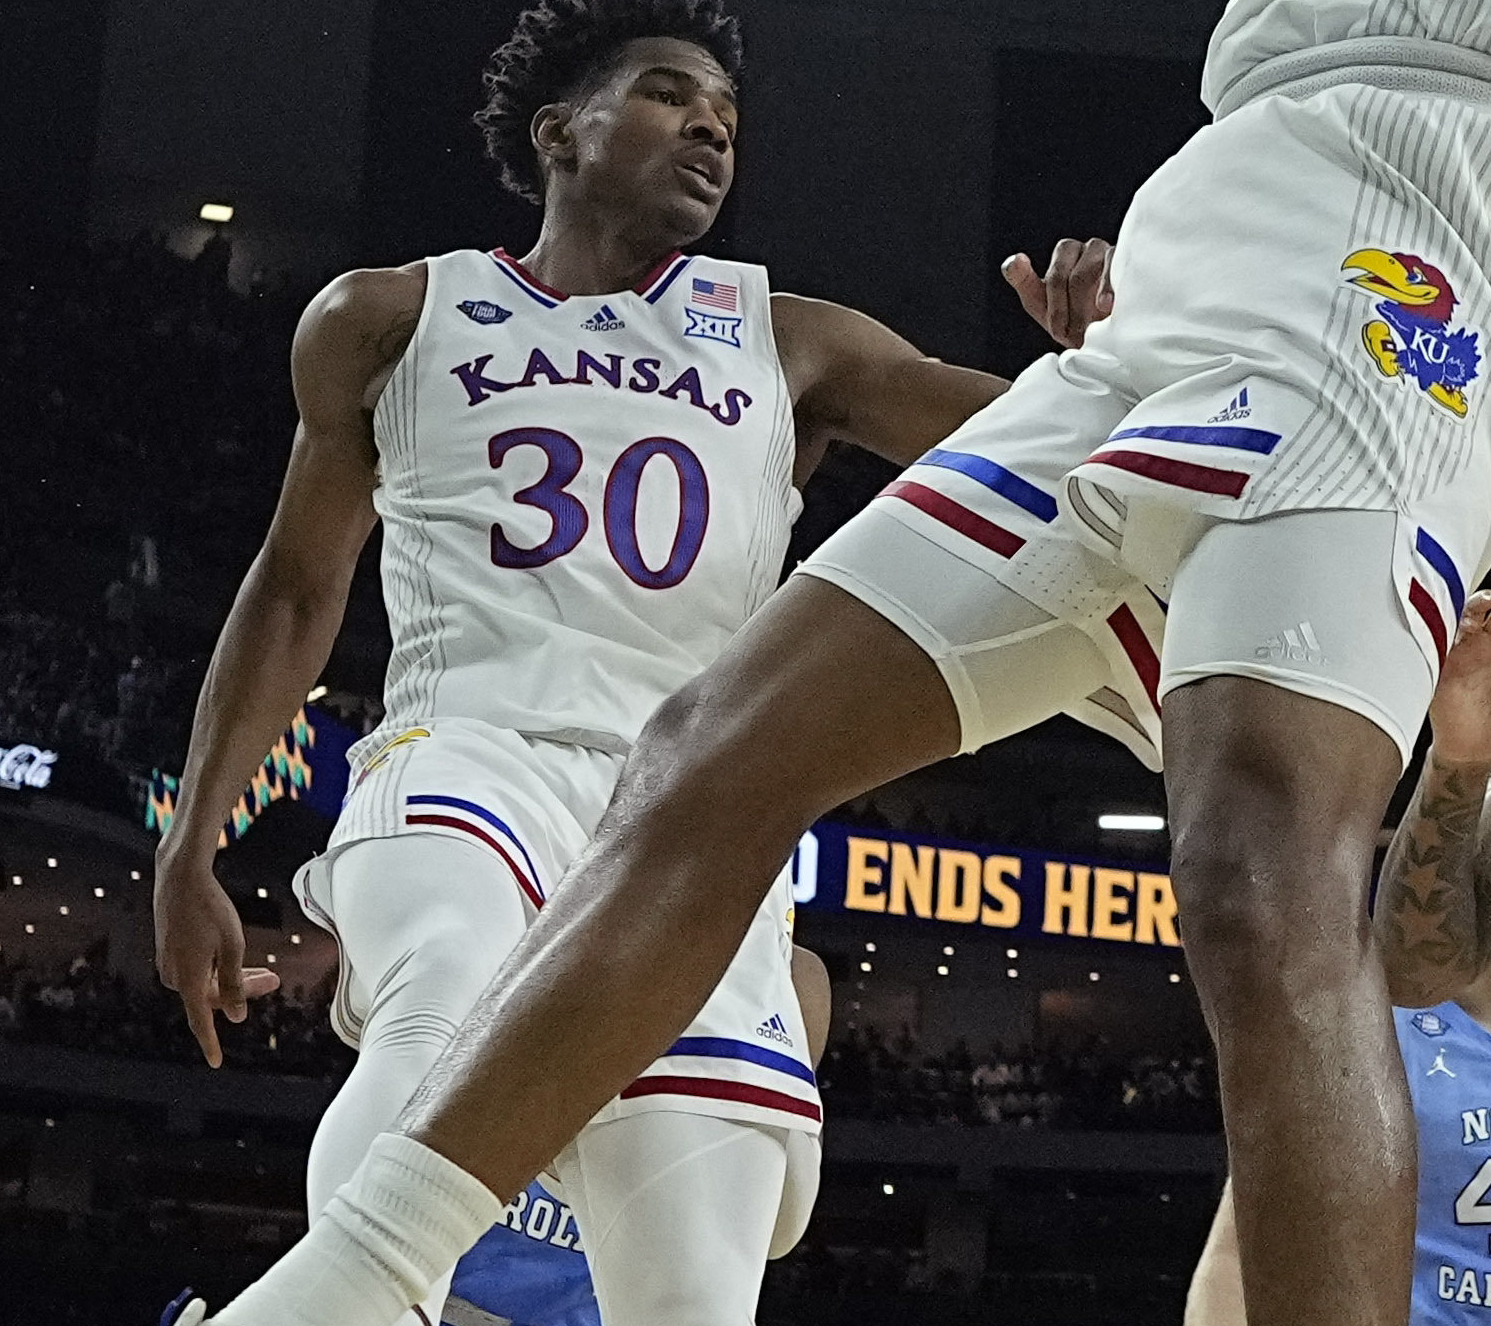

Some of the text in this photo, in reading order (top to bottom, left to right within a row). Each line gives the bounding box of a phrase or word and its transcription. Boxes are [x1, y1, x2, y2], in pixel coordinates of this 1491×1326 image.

[580, 319, 626, 333] adidas
[450, 348, 752, 426] KANSAS
[488, 426, 710, 590] 30
[844, 836, 1022, 929] ENDS
[1041, 861, 1181, 947] HER
